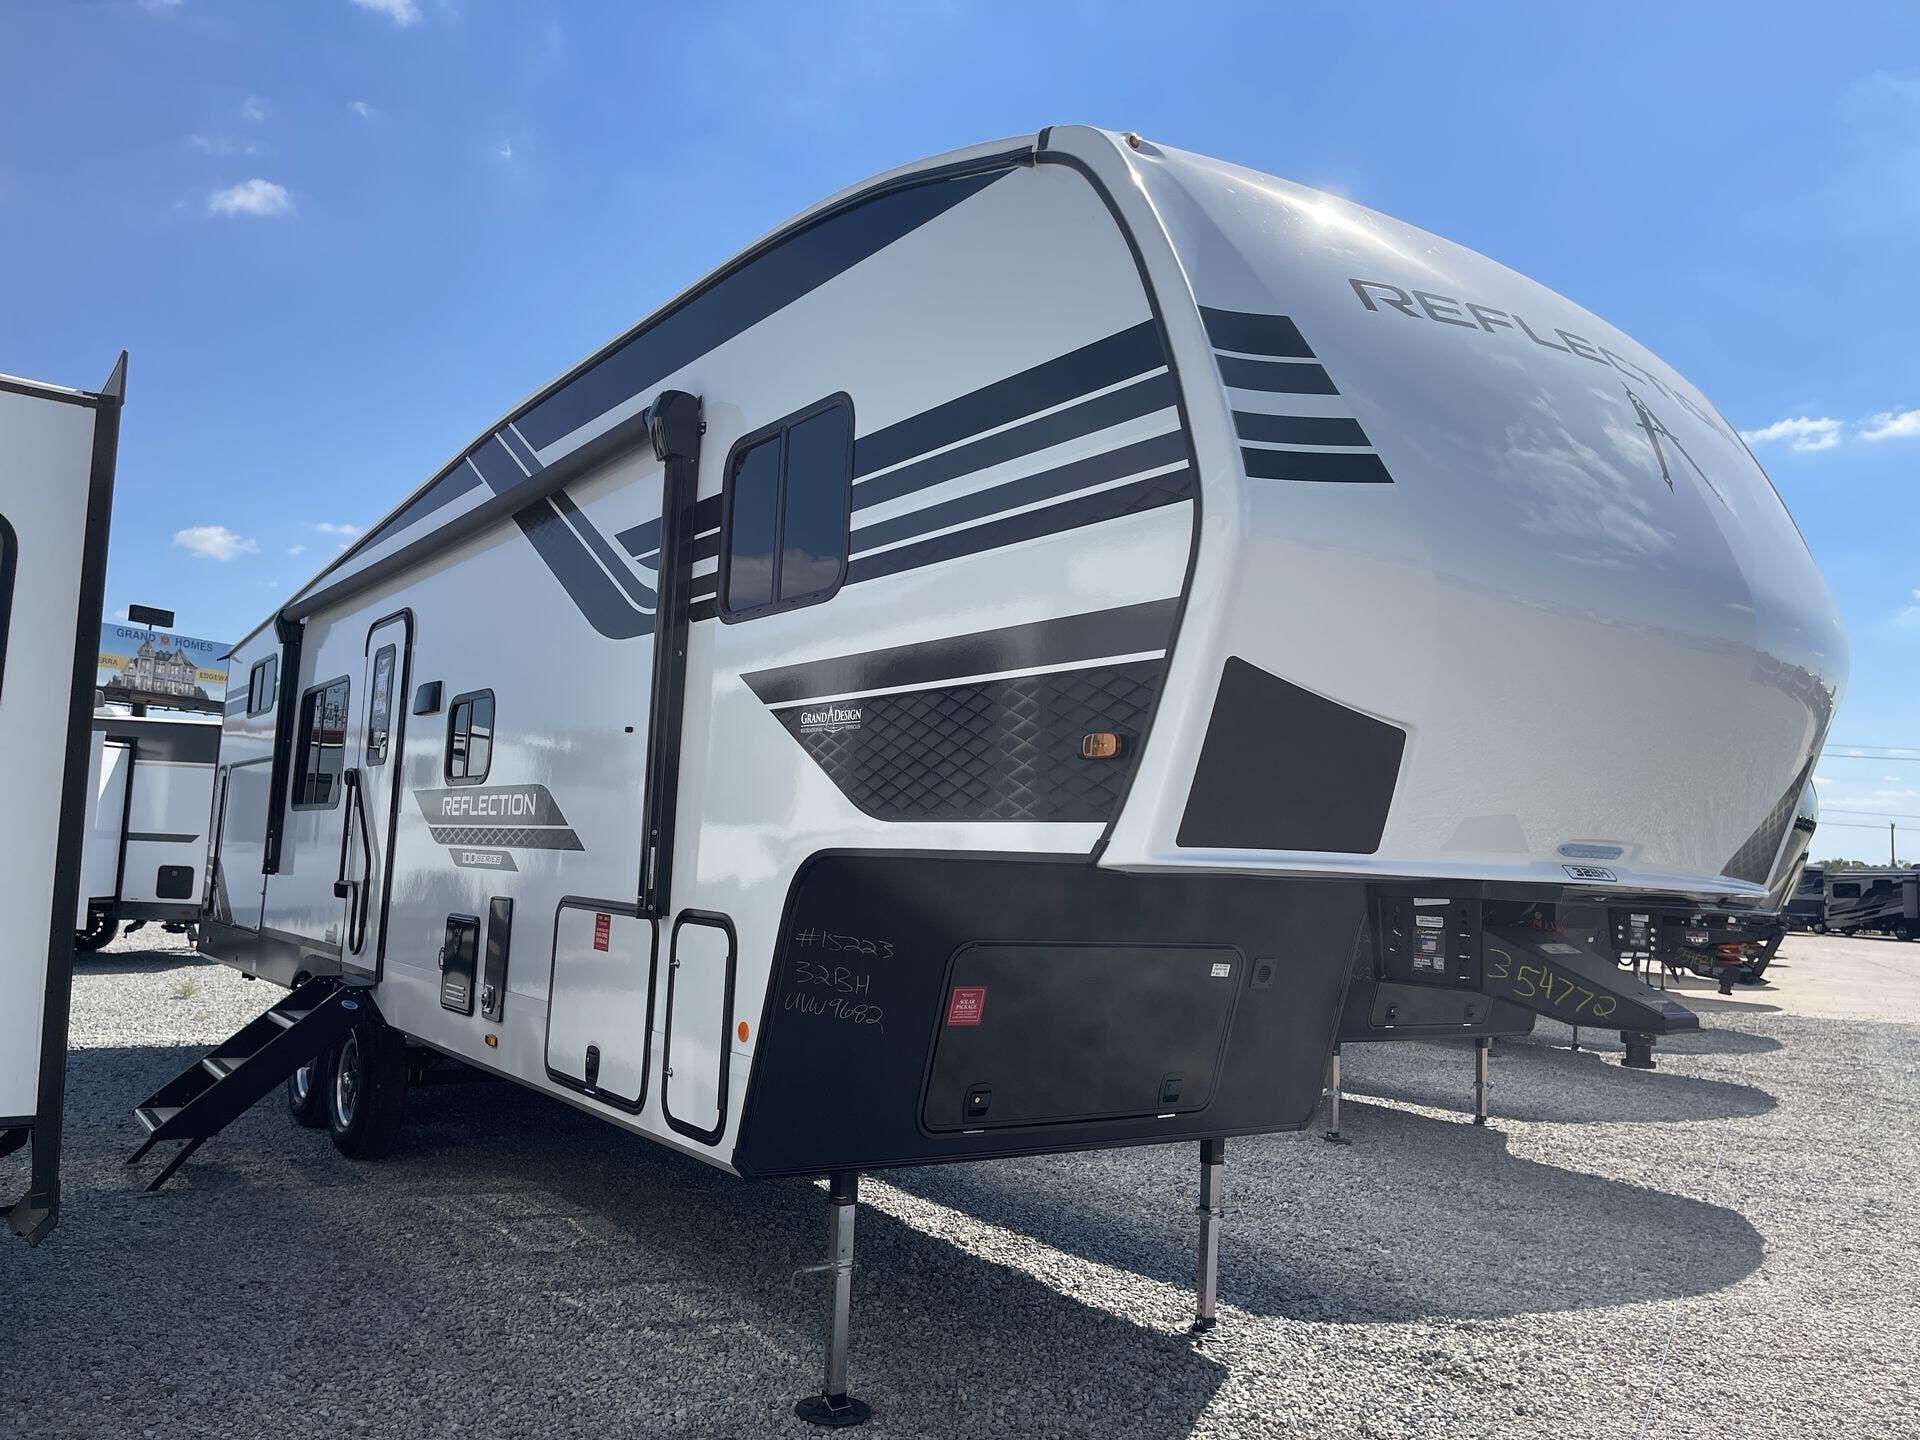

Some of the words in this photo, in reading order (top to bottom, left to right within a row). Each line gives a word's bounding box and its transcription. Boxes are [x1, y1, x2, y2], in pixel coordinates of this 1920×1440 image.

[116, 628, 156, 642] GRAND
[174, 638, 214, 653] HOMES
[801, 711, 827, 724] GRAND
[834, 708, 862, 721] DESIGN
[441, 793, 537, 816] REFLECTION
[794, 927, 896, 959] #15223
[794, 961, 871, 998] 32BH
